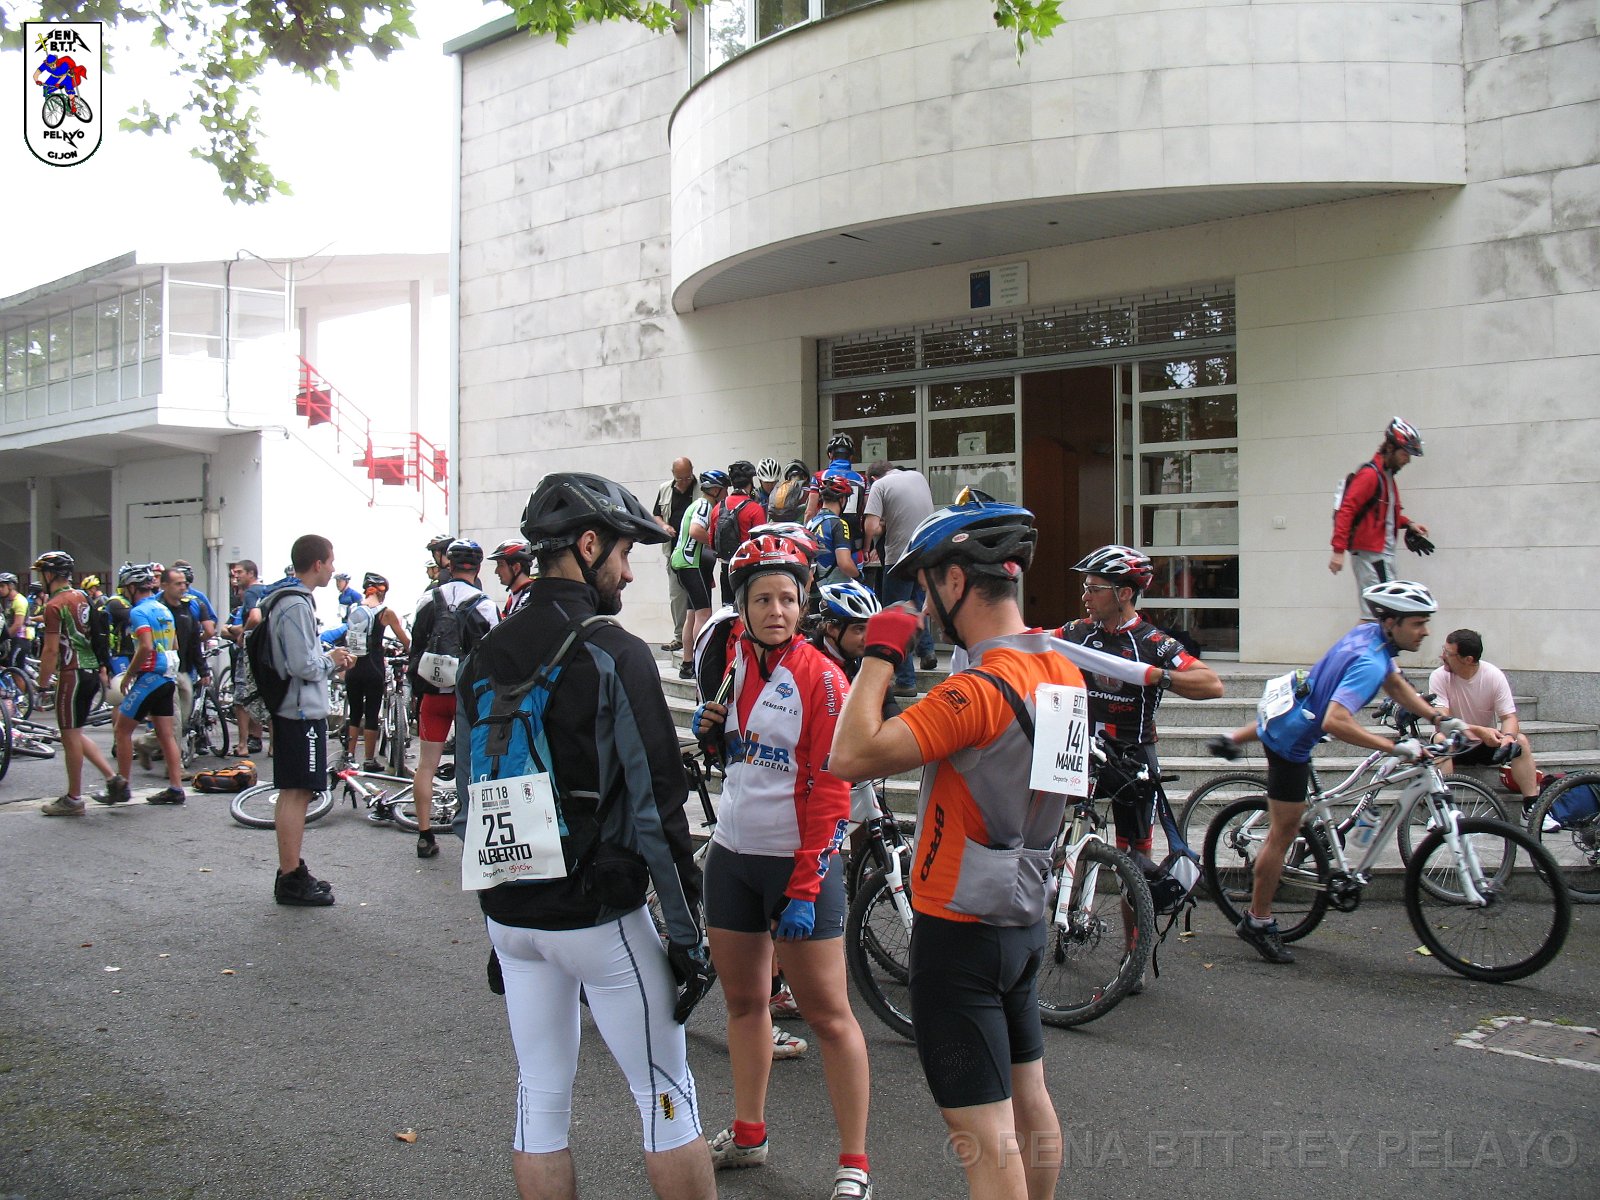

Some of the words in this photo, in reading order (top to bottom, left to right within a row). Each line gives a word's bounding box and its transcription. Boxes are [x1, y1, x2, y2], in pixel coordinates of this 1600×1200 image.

[822, 670, 840, 716] Municipal
[1087, 690, 1136, 702] CHWINN
[1065, 719, 1086, 754] 141
[753, 759, 790, 772] CADENA
[481, 788, 493, 801] BTT
[496, 786, 508, 799] 18
[482, 811, 516, 847] 25
[479, 844, 533, 865] ALBERTO
[482, 868, 505, 878] Deporte
